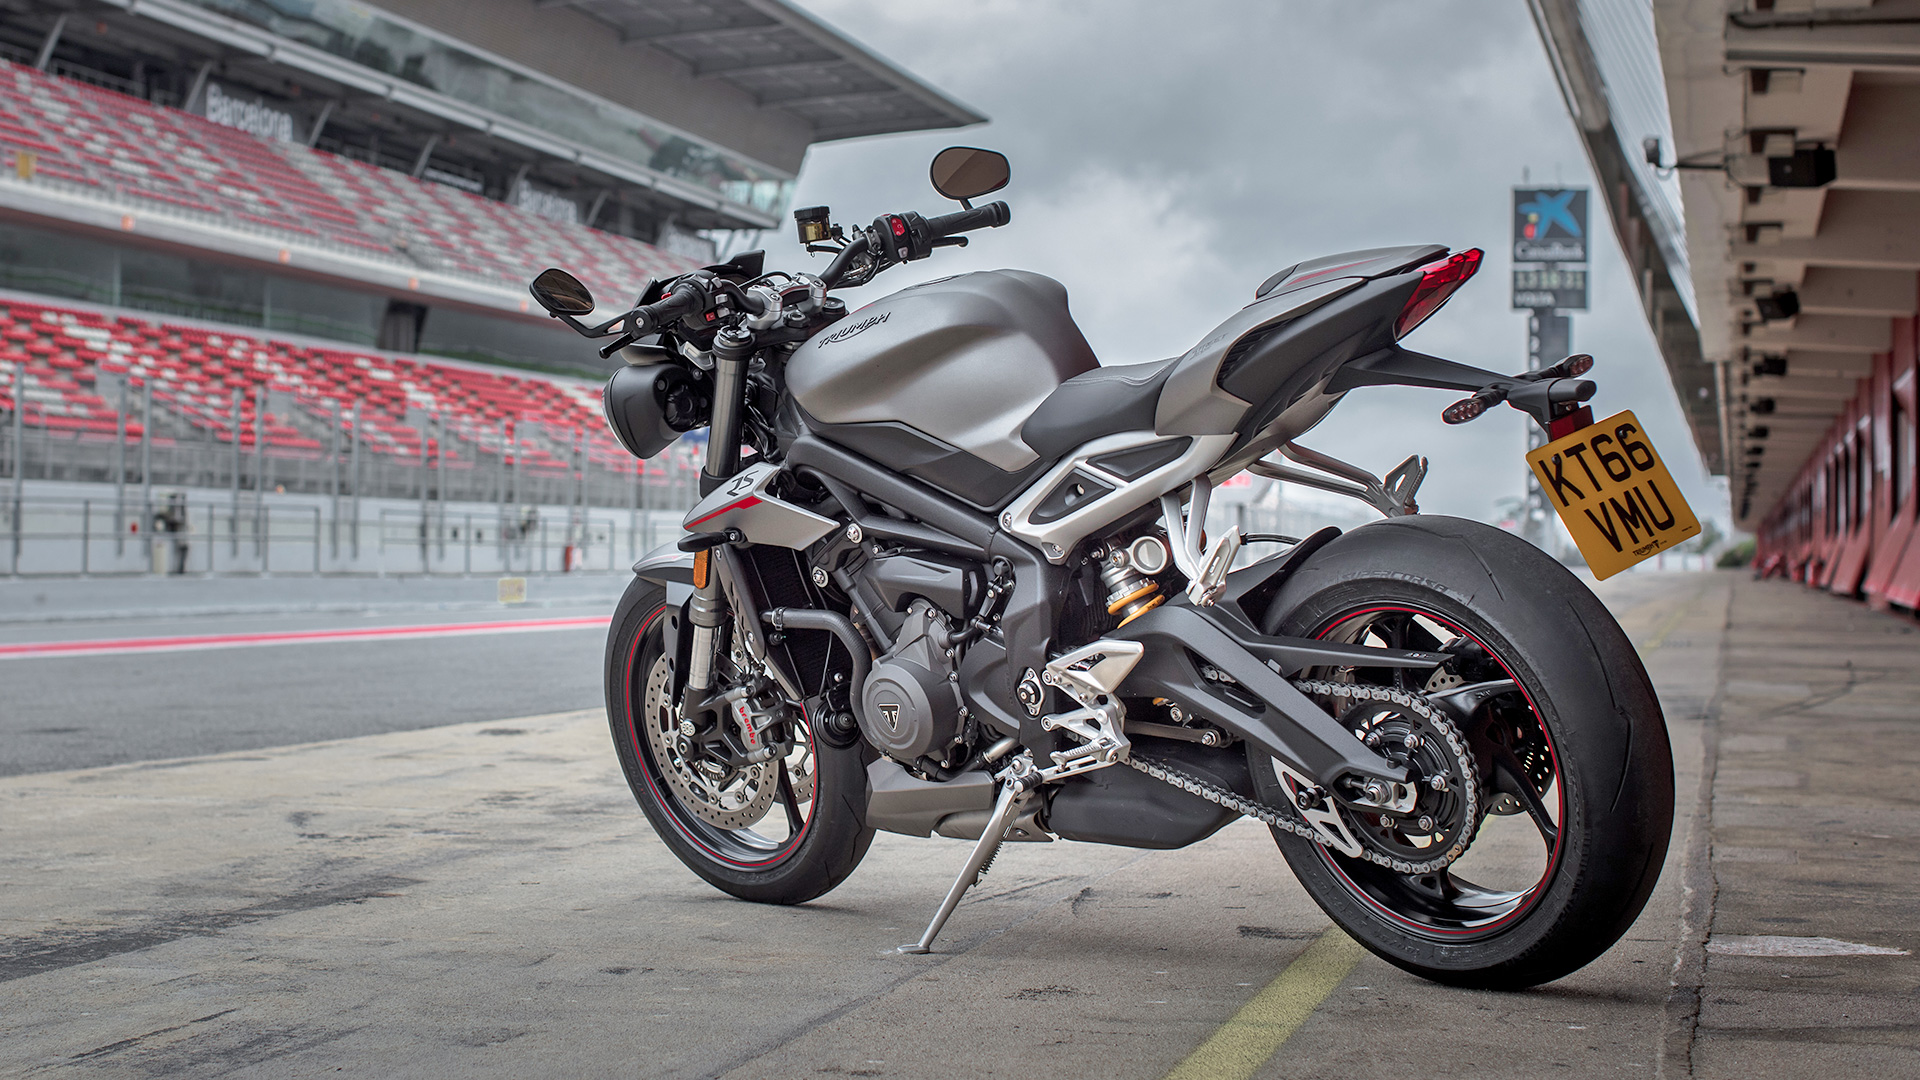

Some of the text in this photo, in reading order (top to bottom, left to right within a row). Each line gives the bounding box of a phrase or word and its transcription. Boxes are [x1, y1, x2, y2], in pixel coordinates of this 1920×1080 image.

[817, 311, 892, 349] TRIUMPH
[1537, 422, 1656, 508] KT66
[1583, 479, 1676, 553] VMU
[739, 706, 757, 745] brembo
